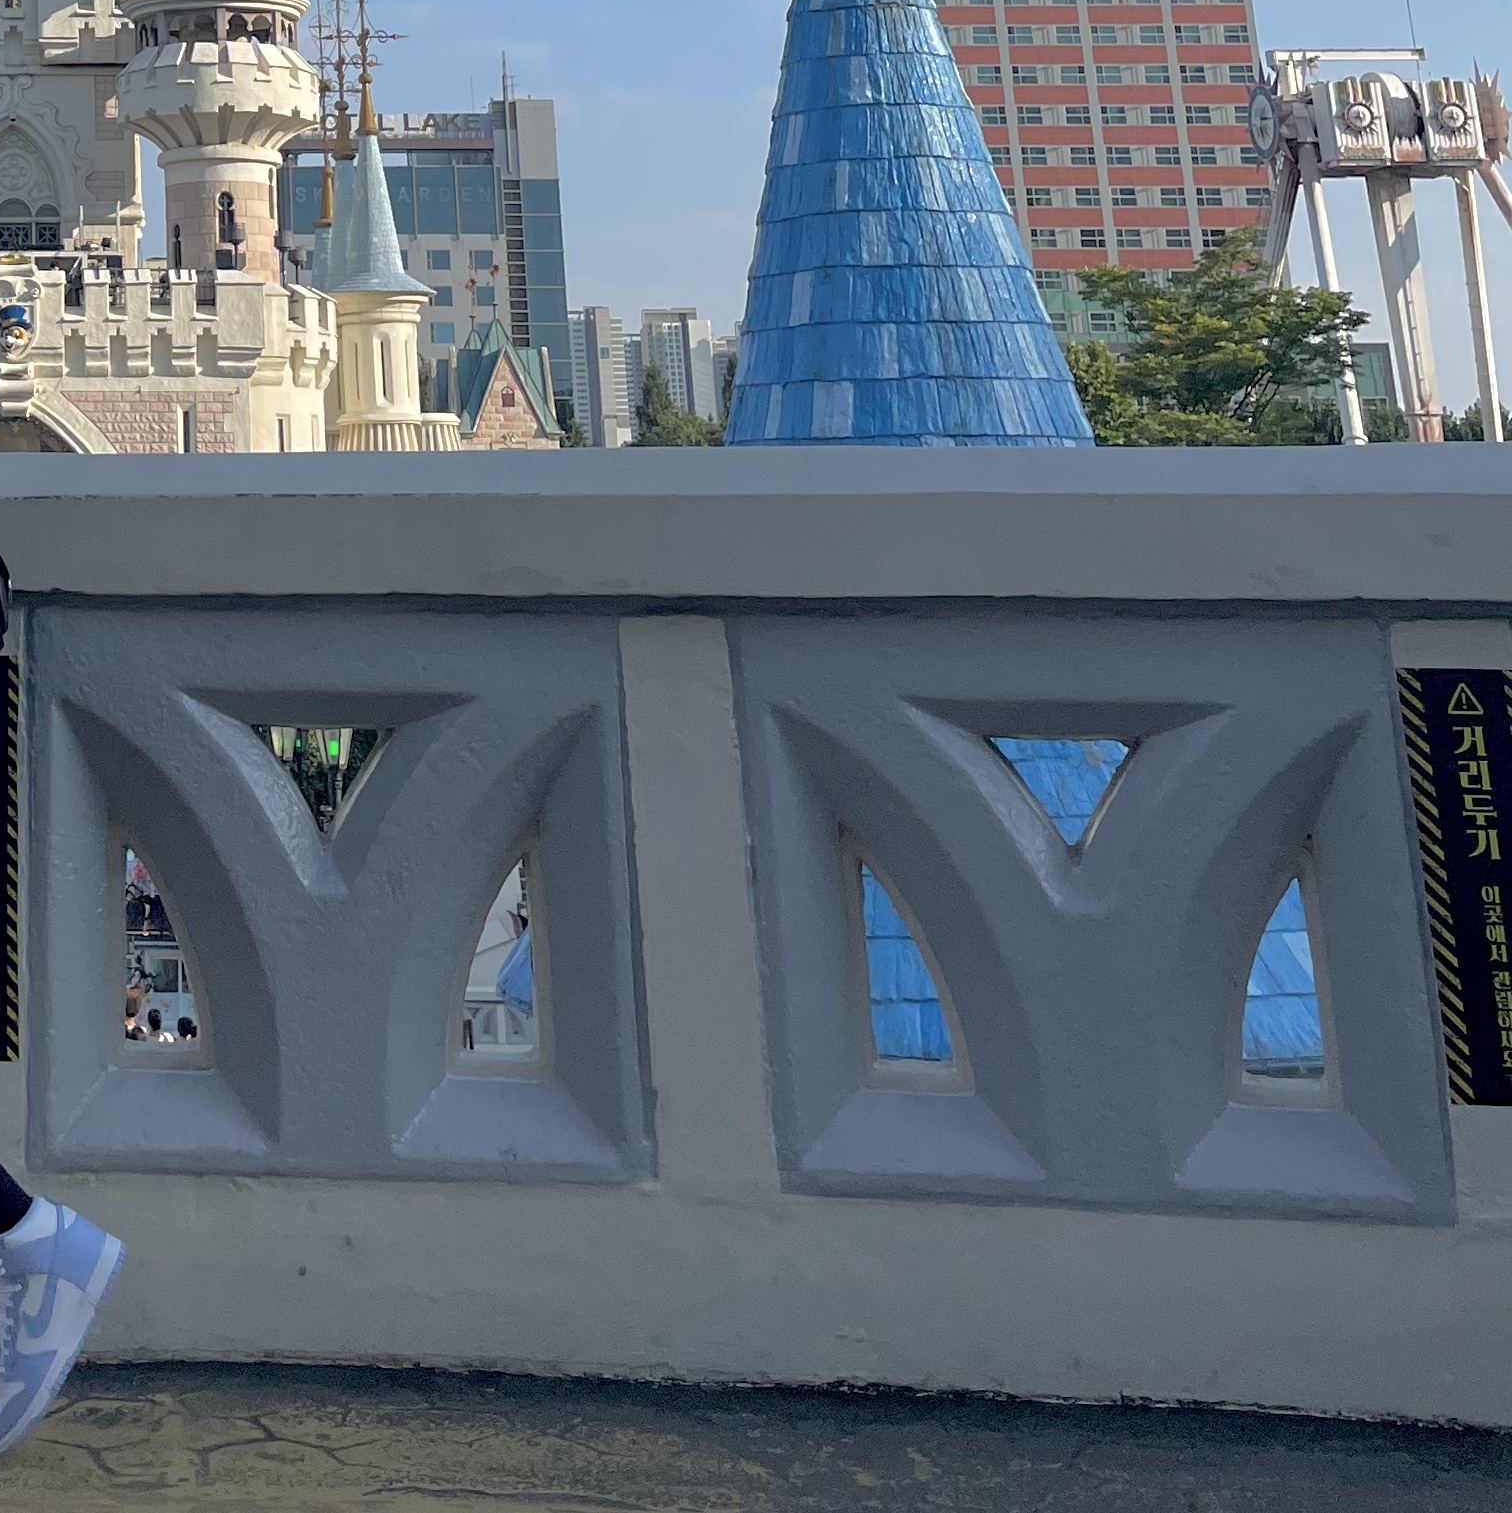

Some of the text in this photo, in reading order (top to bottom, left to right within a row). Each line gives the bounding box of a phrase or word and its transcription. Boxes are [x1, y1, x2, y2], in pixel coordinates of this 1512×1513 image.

[320, 113, 482, 132] OTL LAKE
[397, 186, 493, 203] ARDEN
[1453, 725, 1502, 861] 거리두기
[1481, 885, 1509, 963] 이곳에서
